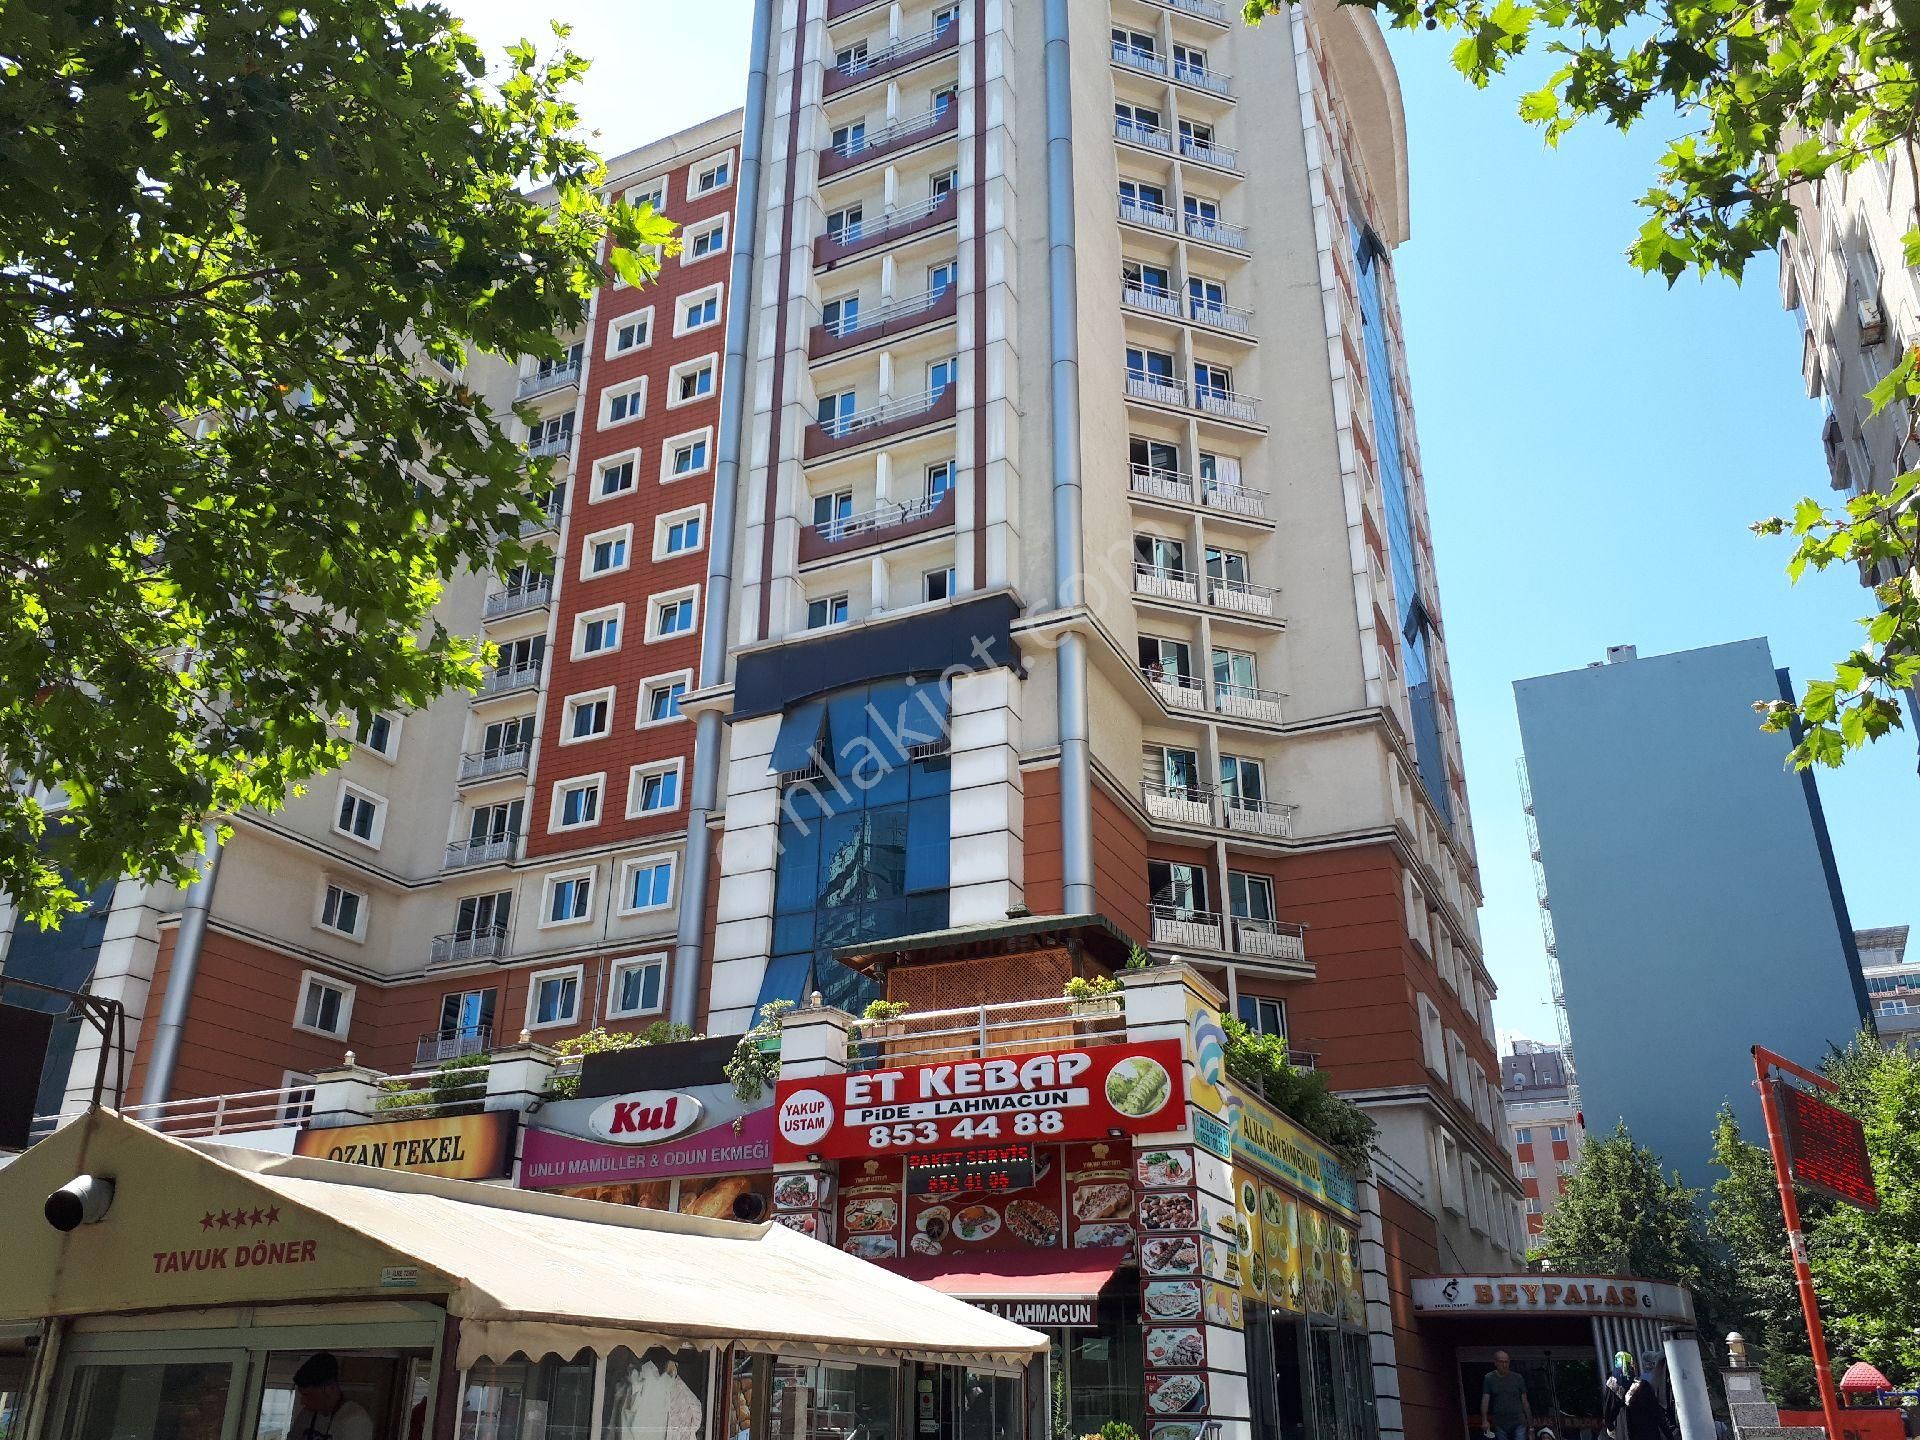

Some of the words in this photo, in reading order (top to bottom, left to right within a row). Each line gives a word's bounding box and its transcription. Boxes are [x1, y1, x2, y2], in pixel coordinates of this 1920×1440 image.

[844, 1071, 904, 1106] ET
[918, 1052, 1092, 1099] KEBAP
[609, 1097, 678, 1134] Kul
[785, 1100, 825, 1116] YAKUP
[934, 1091, 1069, 1117] LAHMACUN
[784, 1116, 826, 1133] USTAM
[868, 1121, 940, 1148] 853
[950, 1117, 1001, 1140] 44
[1013, 1110, 1064, 1135] 88
[1243, 1114, 1266, 1148] ALKA
[328, 1142, 389, 1168] OZAN
[393, 1135, 465, 1167] TEKEL
[529, 1161, 565, 1178] UNLU
[568, 1155, 646, 1174] MAMÜLLER
[650, 1154, 659, 1168] &
[663, 1148, 707, 1166] ODUN
[711, 1140, 769, 1163] EKMEĞİ
[909, 1152, 963, 1170] PAKET
[966, 1144, 1028, 1165] SERVİS
[153, 1247, 229, 1274] TAVUK
[235, 1239, 318, 1268] DÖNER
[1474, 1283, 1638, 1307] BEYPALAS
[1006, 1304, 1091, 1323] LAHMACUN
